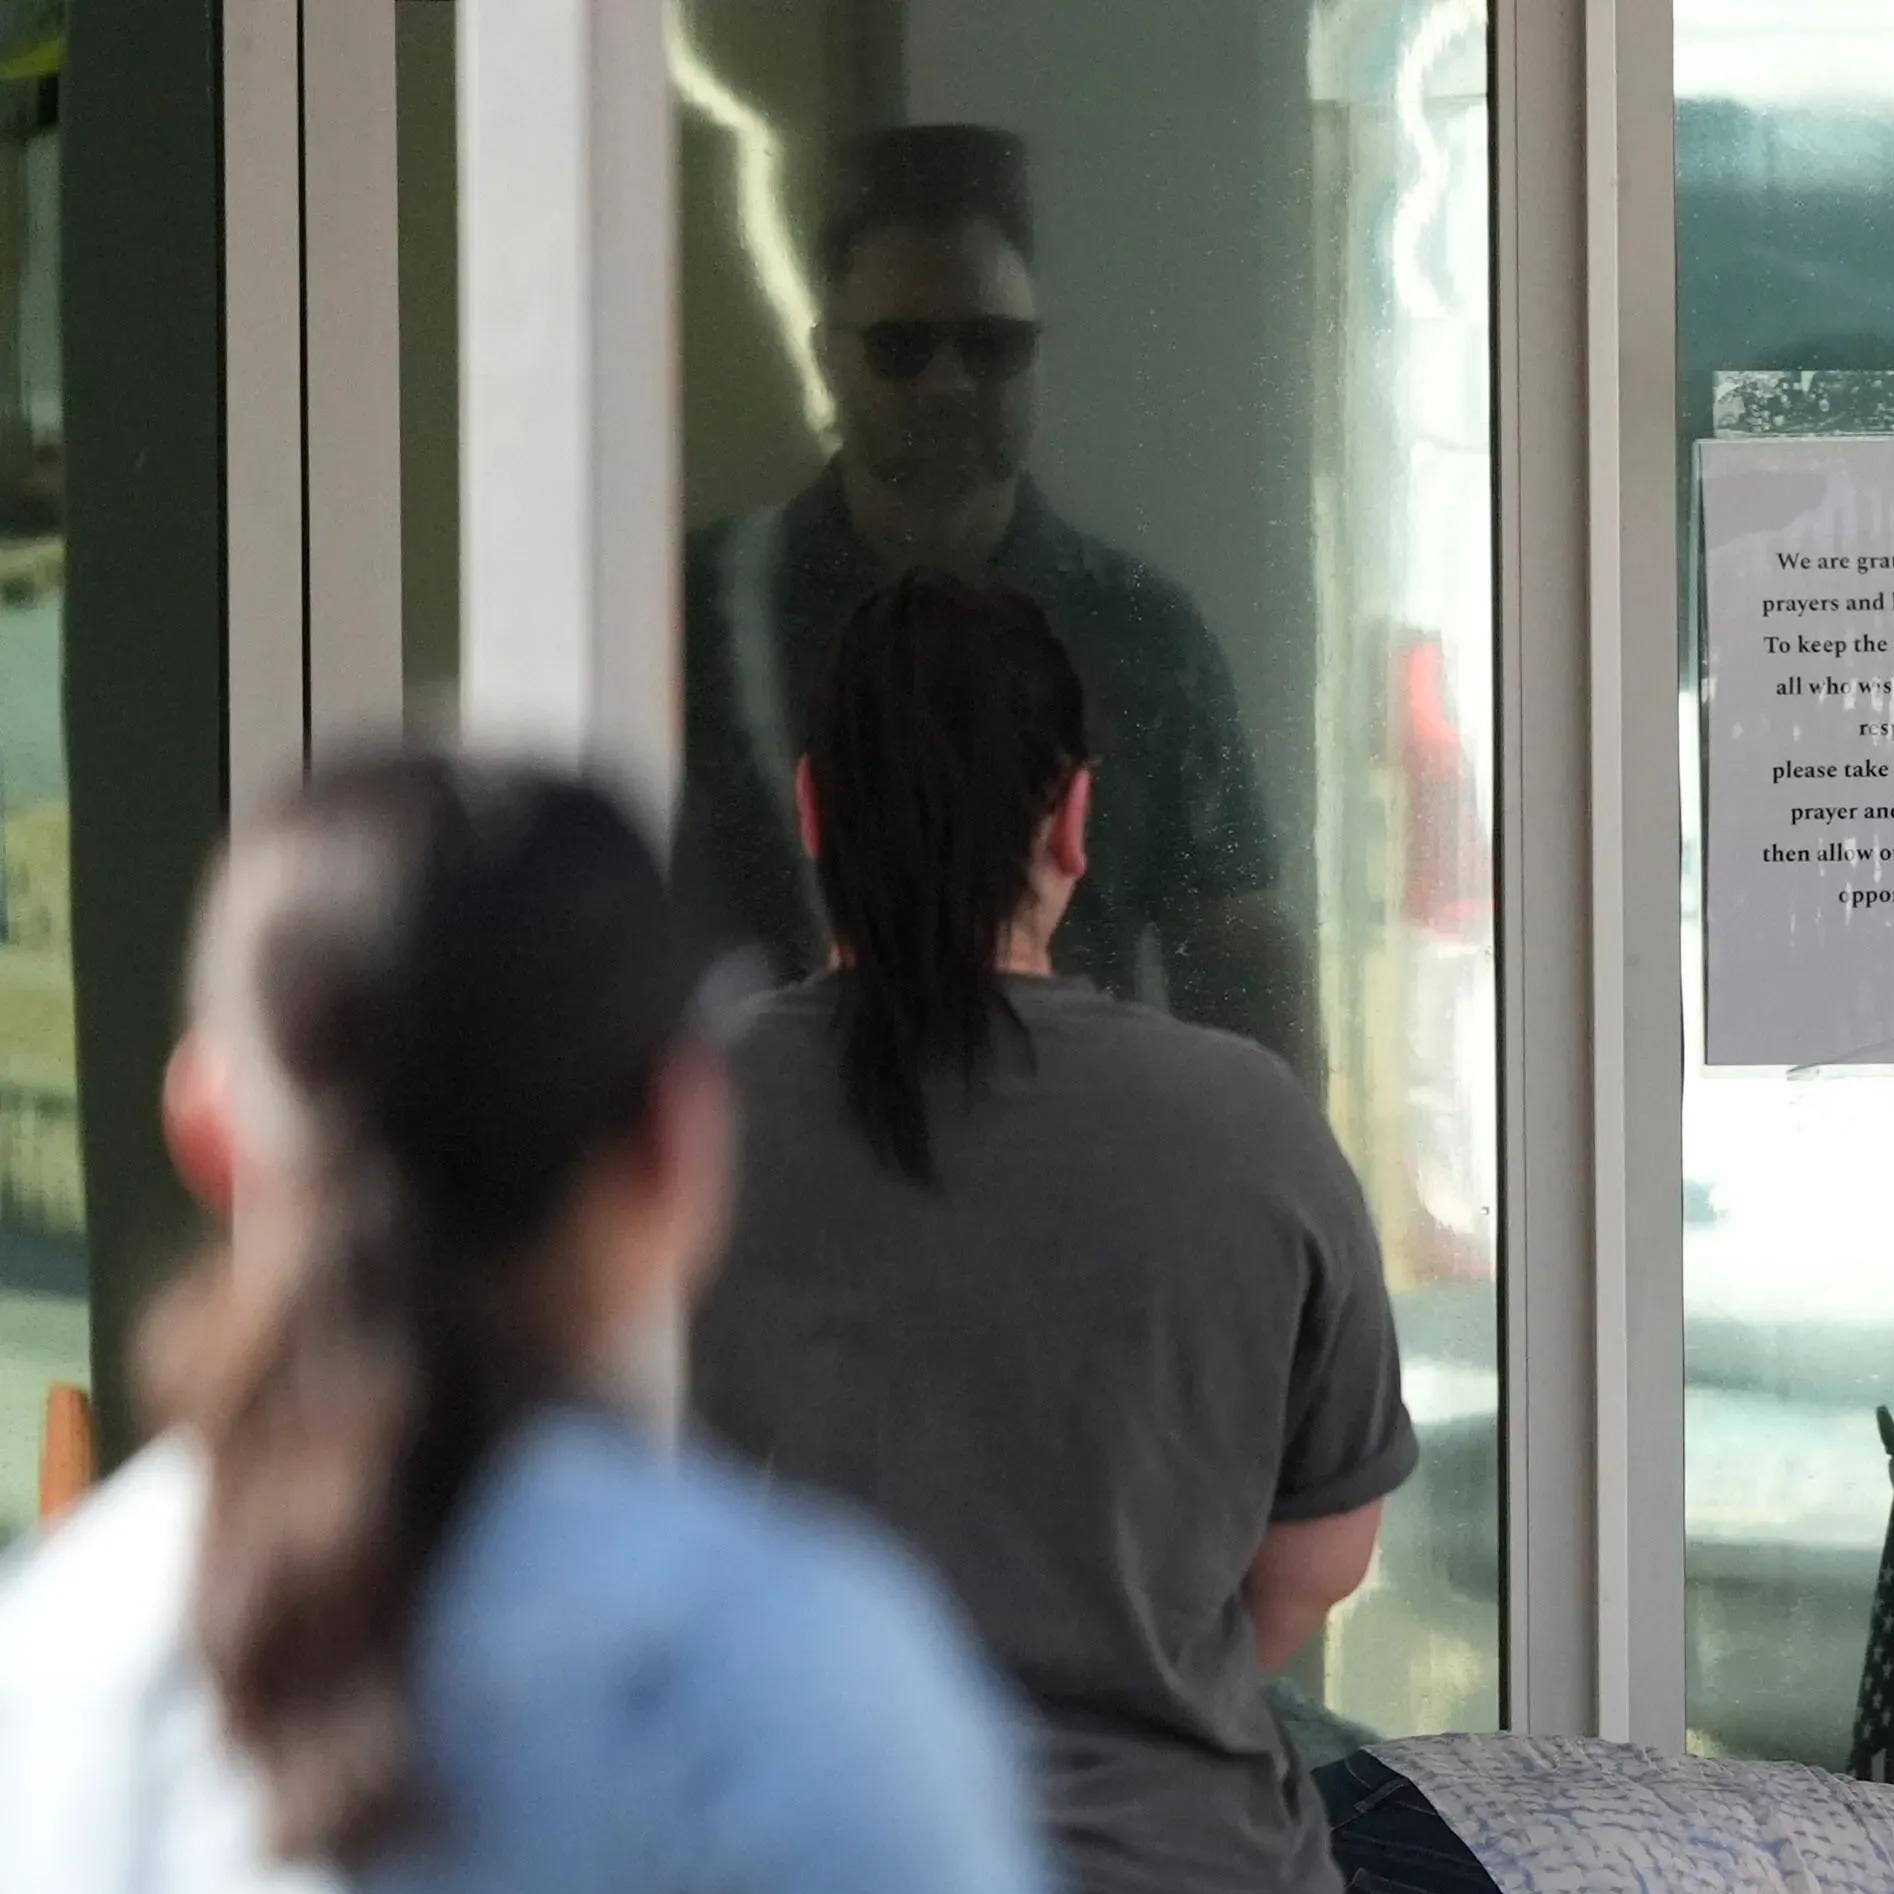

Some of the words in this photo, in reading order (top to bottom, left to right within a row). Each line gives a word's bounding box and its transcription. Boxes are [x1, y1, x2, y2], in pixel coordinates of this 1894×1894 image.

[1776, 551, 1811, 570] We
[1817, 556, 1850, 570] are
[1762, 597, 1840, 617] prayers
[1846, 592, 1885, 611] and
[1763, 636, 1791, 654] To
[1798, 634, 1847, 658] keep
[1854, 633, 1888, 653] the
[1776, 676, 1802, 696] all
[1809, 675, 1850, 696] who
[1773, 760, 1838, 784] please
[1844, 759, 1889, 778] take
[1791, 805, 1859, 826] prayer
[1763, 843, 1811, 863] then
[1817, 842, 1874, 863] allow
